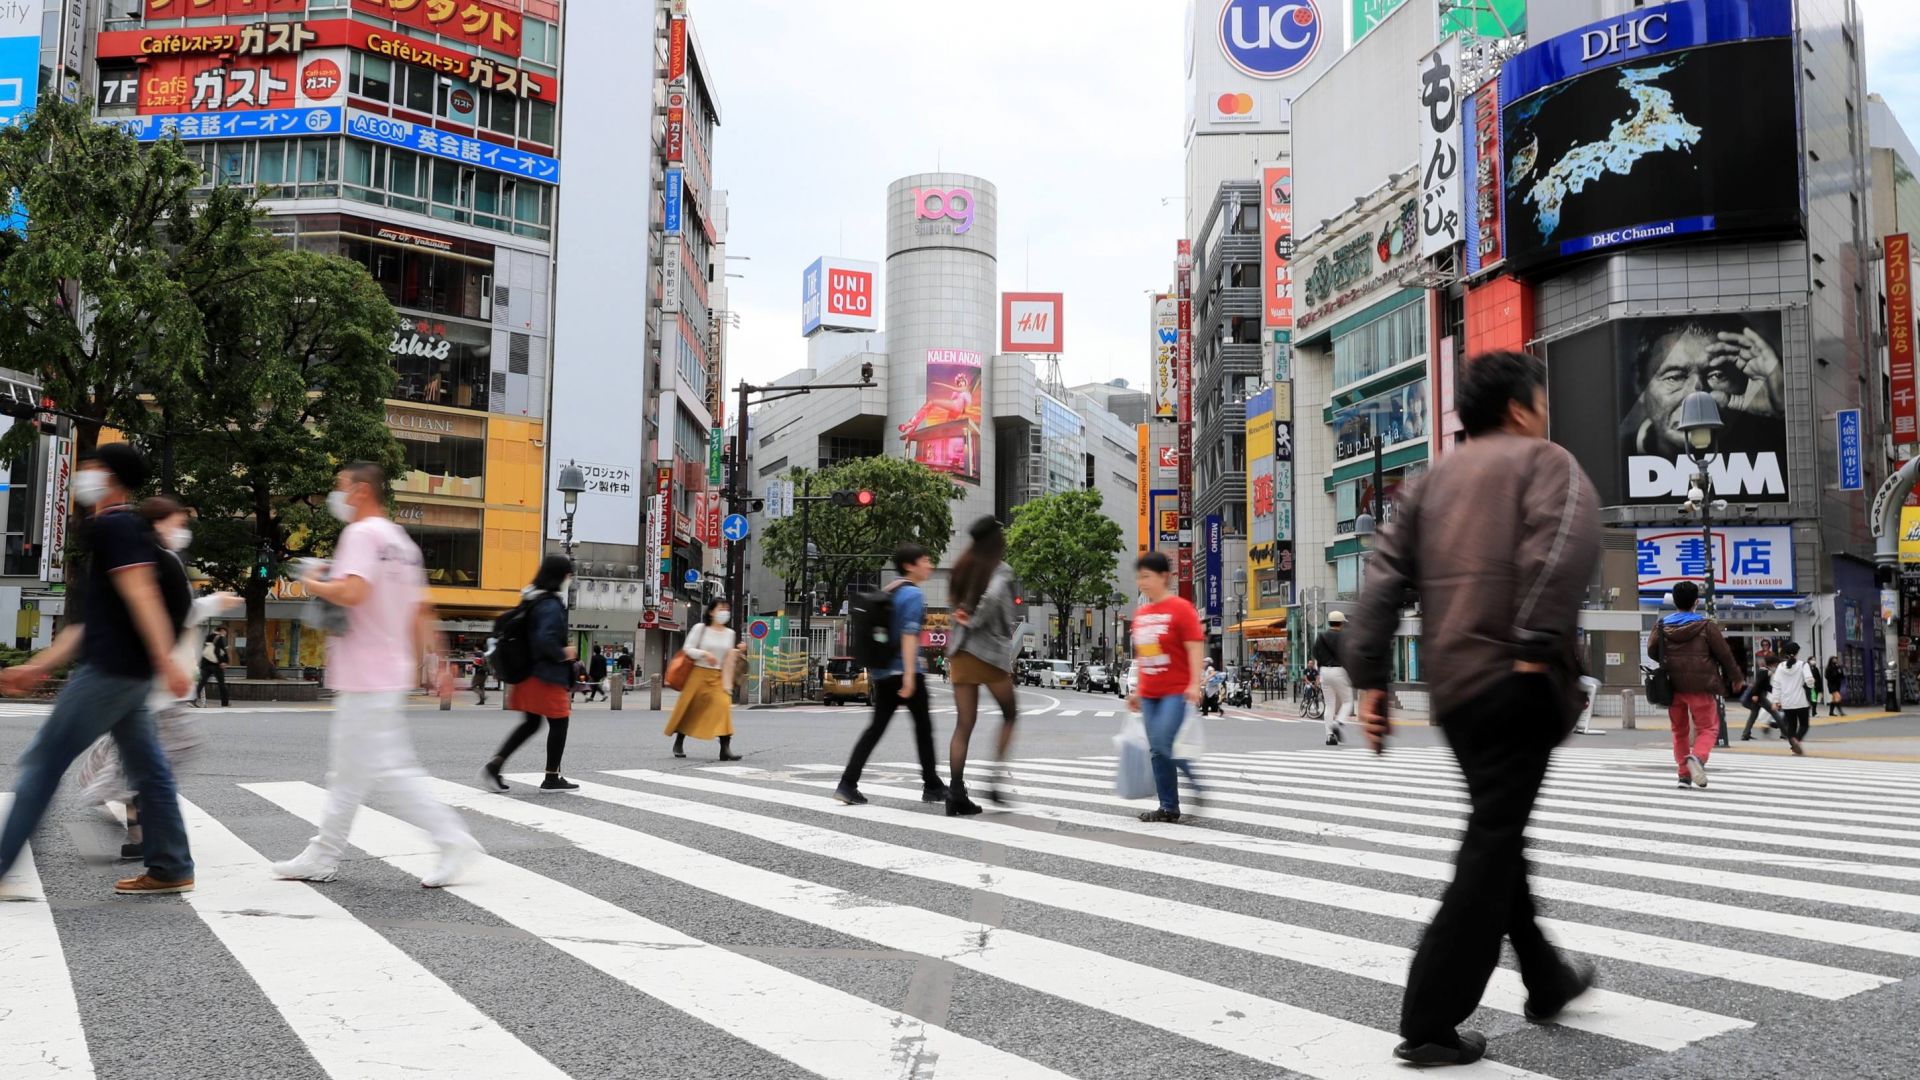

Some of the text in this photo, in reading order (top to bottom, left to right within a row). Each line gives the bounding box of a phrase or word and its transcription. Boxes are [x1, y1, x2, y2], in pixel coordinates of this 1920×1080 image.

[70, 0, 81, 57] 血ルーム
[360, 0, 516, 42] タクト
[1580, 12, 1667, 62] DHC
[240, 23, 315, 54] ガスト
[103, 79, 137, 103] 7F
[147, 77, 188, 95] Café
[192, 69, 287, 109] ガスト
[306, 77, 337, 89] ガスト
[469, 57, 541, 98] ガスト
[147, 95, 186, 106] レストラン
[159, 113, 298, 137] 英会話イーオン
[308, 113, 329, 128] 6F
[671, 121, 680, 154] ガスト
[355, 115, 555, 176] AEON 英会話イーオン
[1422, 52, 1458, 239] もんじゃ
[1475, 87, 1496, 257] 三千里薬品
[911, 187, 974, 234] 109
[1592, 223, 1674, 248] DHC Channel
[666, 250, 677, 307] 渋谷駅前ビル
[833, 274, 864, 293] UNI
[833, 293, 867, 312] QLO
[1018, 312, 1048, 332] H&M
[1889, 239, 1915, 434] クスリのことなら 三千里
[927, 351, 981, 365] KALEN ANZAI
[1337, 424, 1400, 457] Euphria
[583, 479, 630, 494] イン製作中
[1628, 451, 1785, 498] DMM
[1638, 539, 1771, 576] 堂書店
[929, 632, 947, 646] 109
